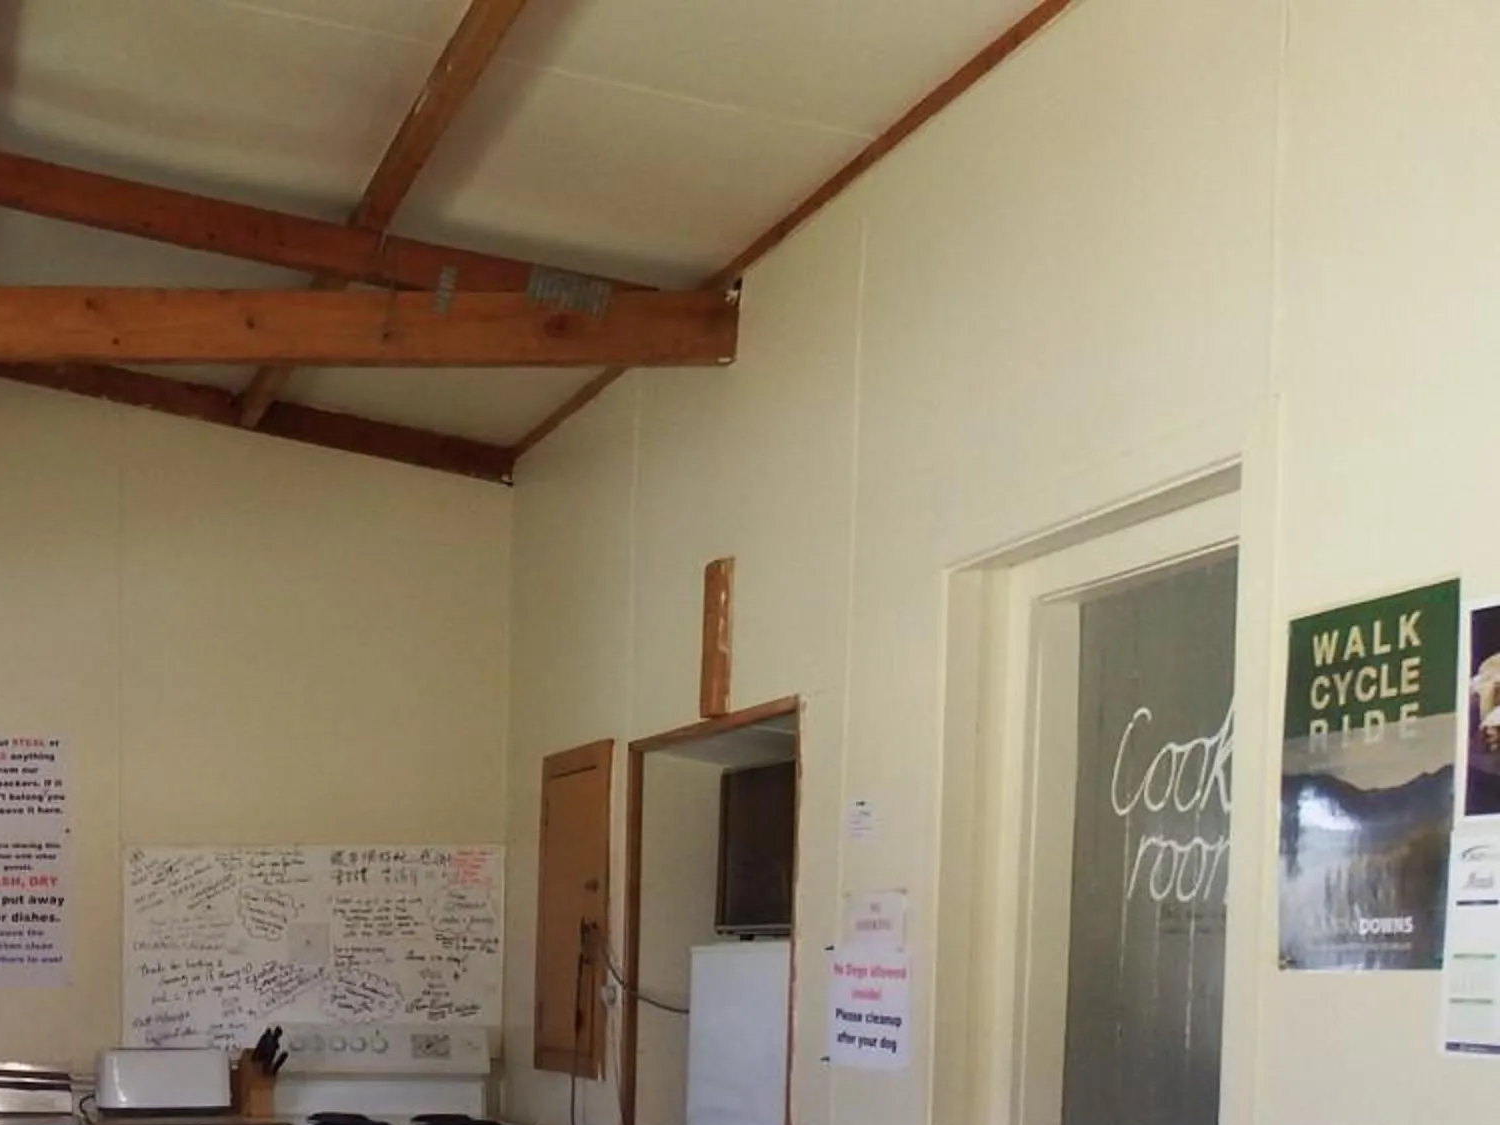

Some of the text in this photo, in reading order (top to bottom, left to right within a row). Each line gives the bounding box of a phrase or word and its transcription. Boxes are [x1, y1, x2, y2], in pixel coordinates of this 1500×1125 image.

[1312, 610, 1422, 668] WALK
[1310, 655, 1422, 710] CYCLE
[1308, 702, 1421, 754] RIDE
[10, 752, 56, 762] anything
[1111, 694, 1233, 817] Cook
[28, 875, 59, 887] DRY
[1, 894, 25, 907] put
[27, 895, 65, 908] away
[11, 911, 61, 924] dishes.
[1358, 916, 1414, 935] DOWNS
[835, 1007, 863, 1023] Please
[836, 1030, 898, 1054] after your dog
